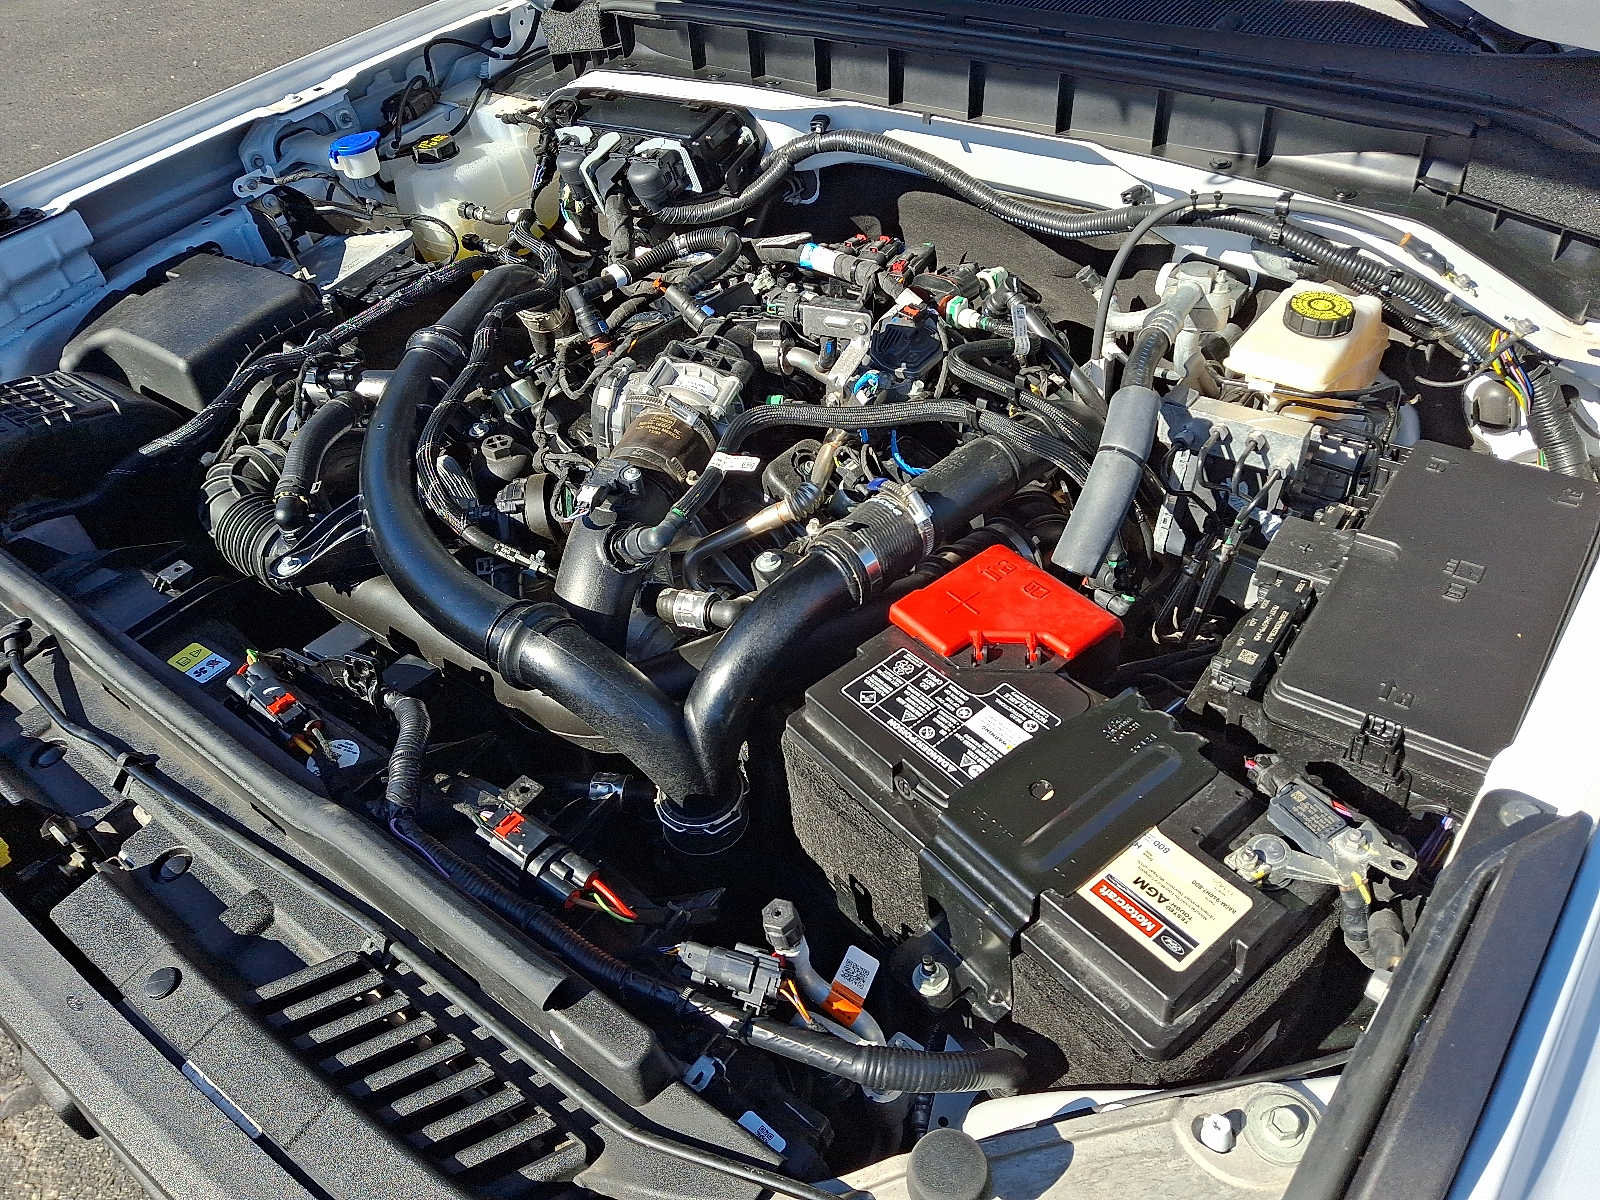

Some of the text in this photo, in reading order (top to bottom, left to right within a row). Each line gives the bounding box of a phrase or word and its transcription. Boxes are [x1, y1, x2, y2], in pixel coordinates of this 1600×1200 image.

[918, 681, 930, 690] DO
[922, 676, 936, 687] NOT
[980, 724, 1007, 745] WARNING
[1132, 876, 1169, 905] AGM
[1097, 884, 1156, 932] Motorcraft
